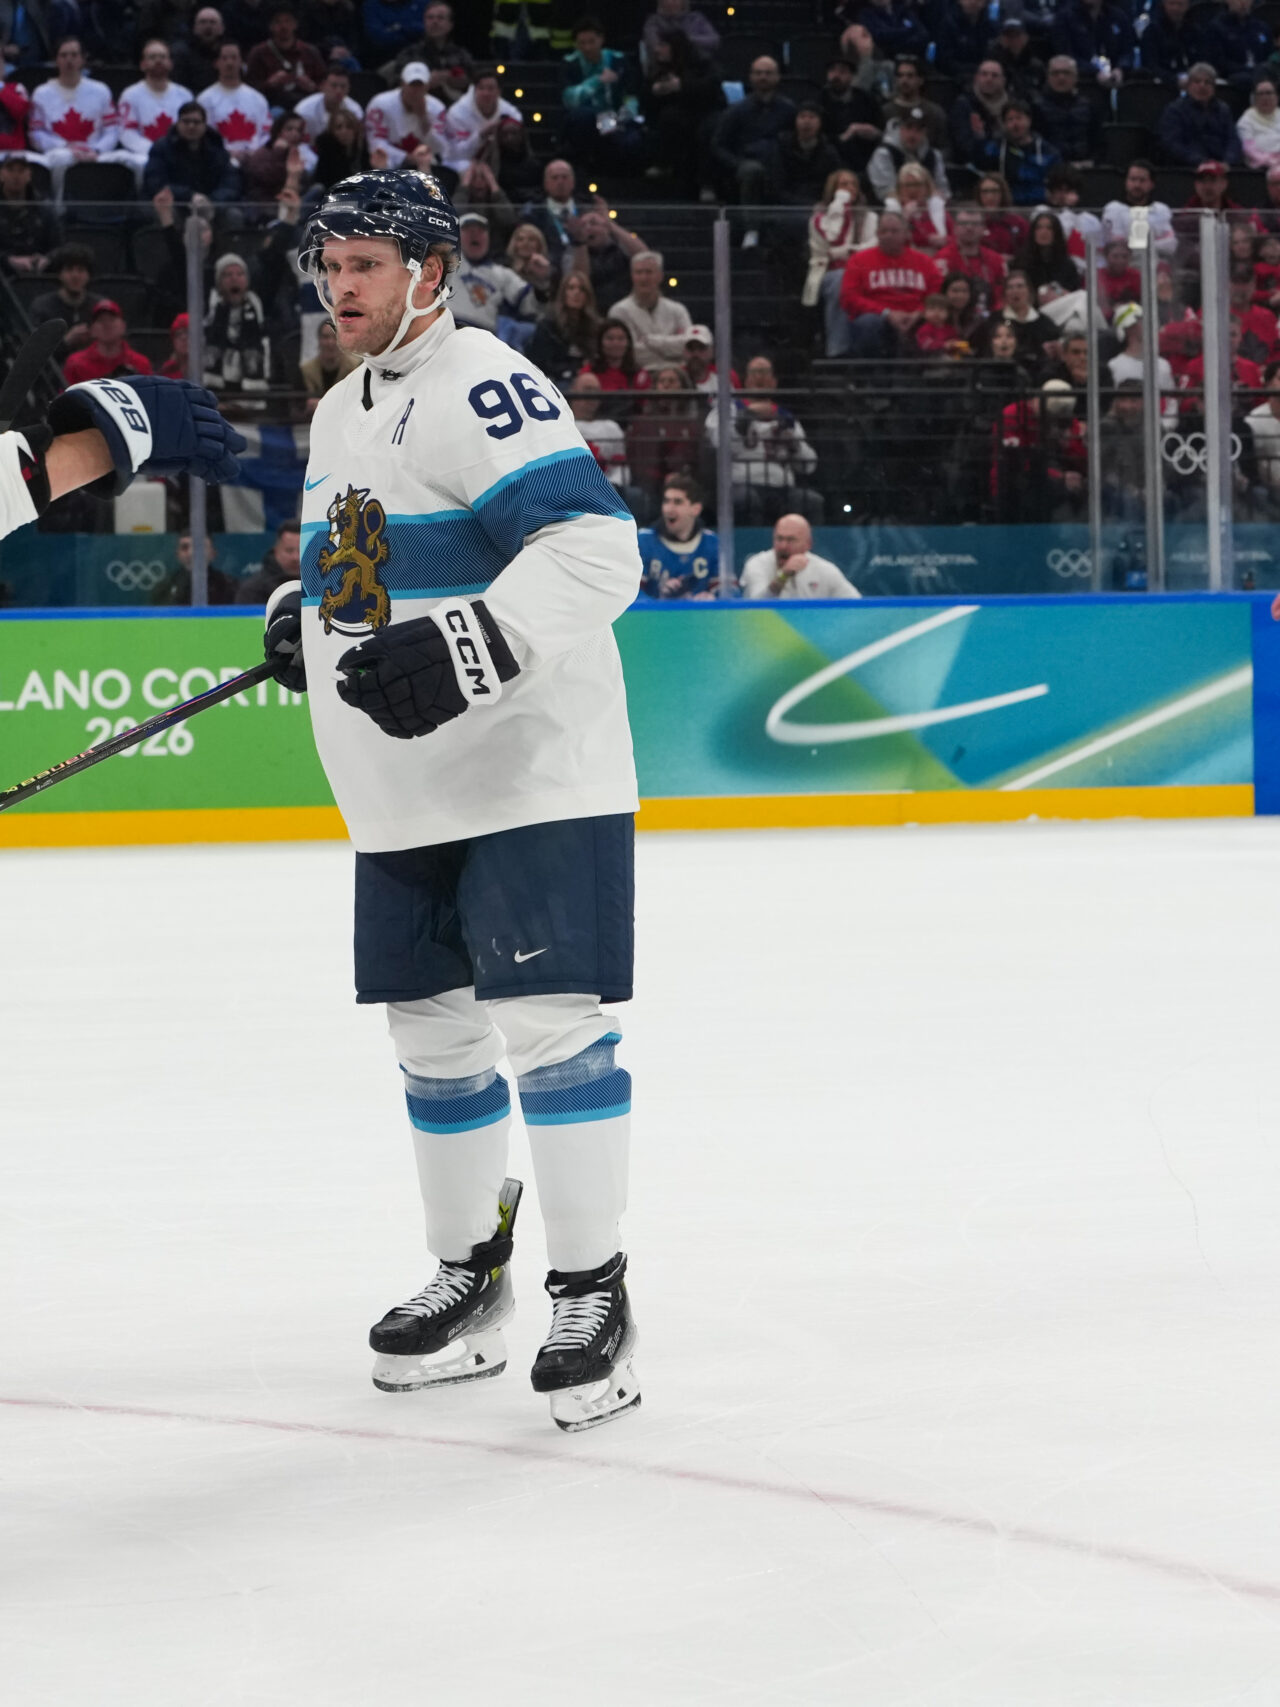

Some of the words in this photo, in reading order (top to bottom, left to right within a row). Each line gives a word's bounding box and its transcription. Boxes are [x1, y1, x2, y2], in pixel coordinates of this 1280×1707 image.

[427, 216, 451, 229] CCM
[869, 267, 927, 291] CANADA
[391, 398, 415, 445] A
[467, 372, 562, 441] 96
[445, 609, 491, 696] CCM
[142, 667, 302, 709] CORTI
[86, 716, 195, 758] 2026
